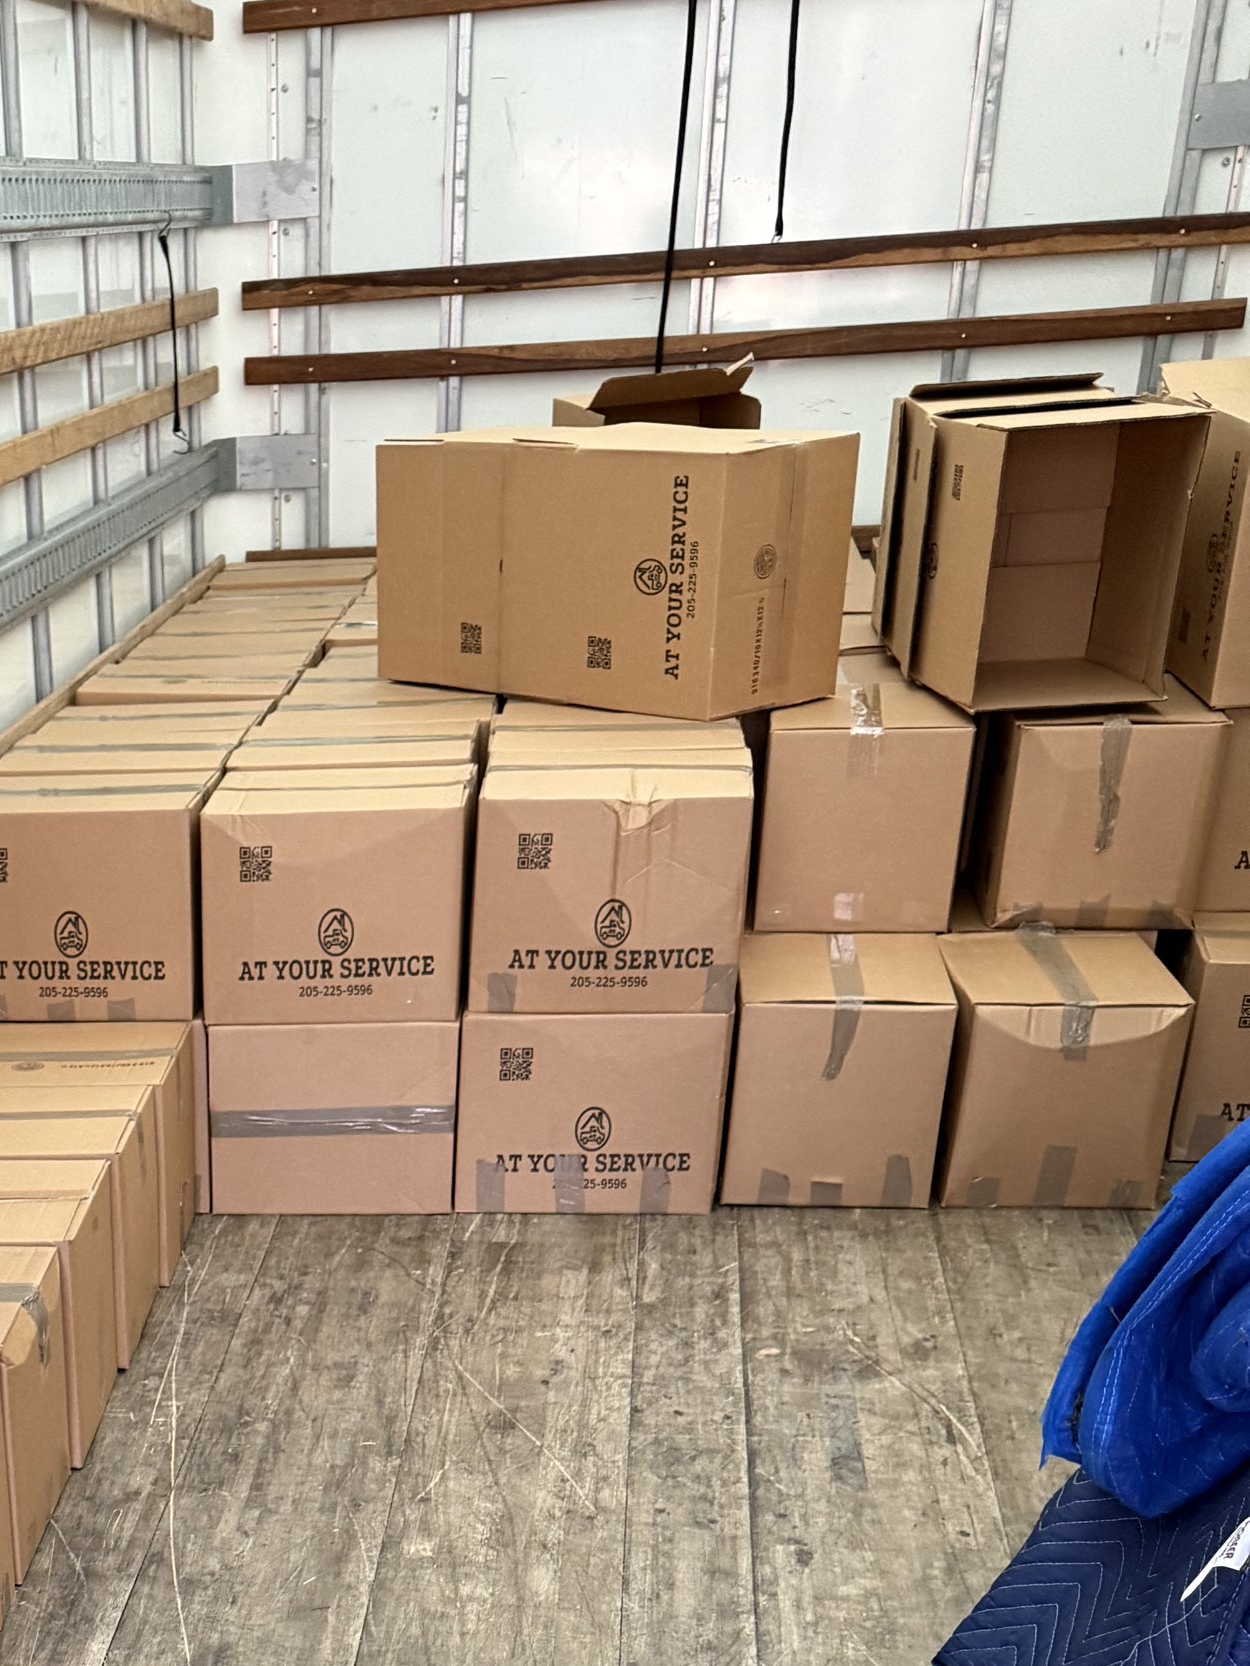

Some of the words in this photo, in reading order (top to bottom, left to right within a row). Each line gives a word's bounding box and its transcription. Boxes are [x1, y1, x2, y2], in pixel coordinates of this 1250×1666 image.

[670, 475, 689, 575] SERVICE
[687, 541, 699, 619] 205-225-9596
[667, 582, 683, 645] YOUR
[665, 650, 679, 680] AT
[238, 961, 267, 981] AT
[272, 959, 335, 981] YOUR
[339, 955, 435, 979] SERVICE
[508, 950, 539, 970] AT
[544, 949, 609, 970] YOUR
[614, 948, 714, 970] SERVICE
[13, 960, 71, 980] YOUR
[77, 960, 166, 981] SERVICE
[38, 986, 109, 998] 205-225-9596
[299, 984, 373, 998] 205-225-9596
[570, 976, 648, 988] 205-225-9596
[1218, 1102, 1250, 1122] AT
[494, 1154, 523, 1173] AT
[594, 1152, 691, 1173] SERVICE
